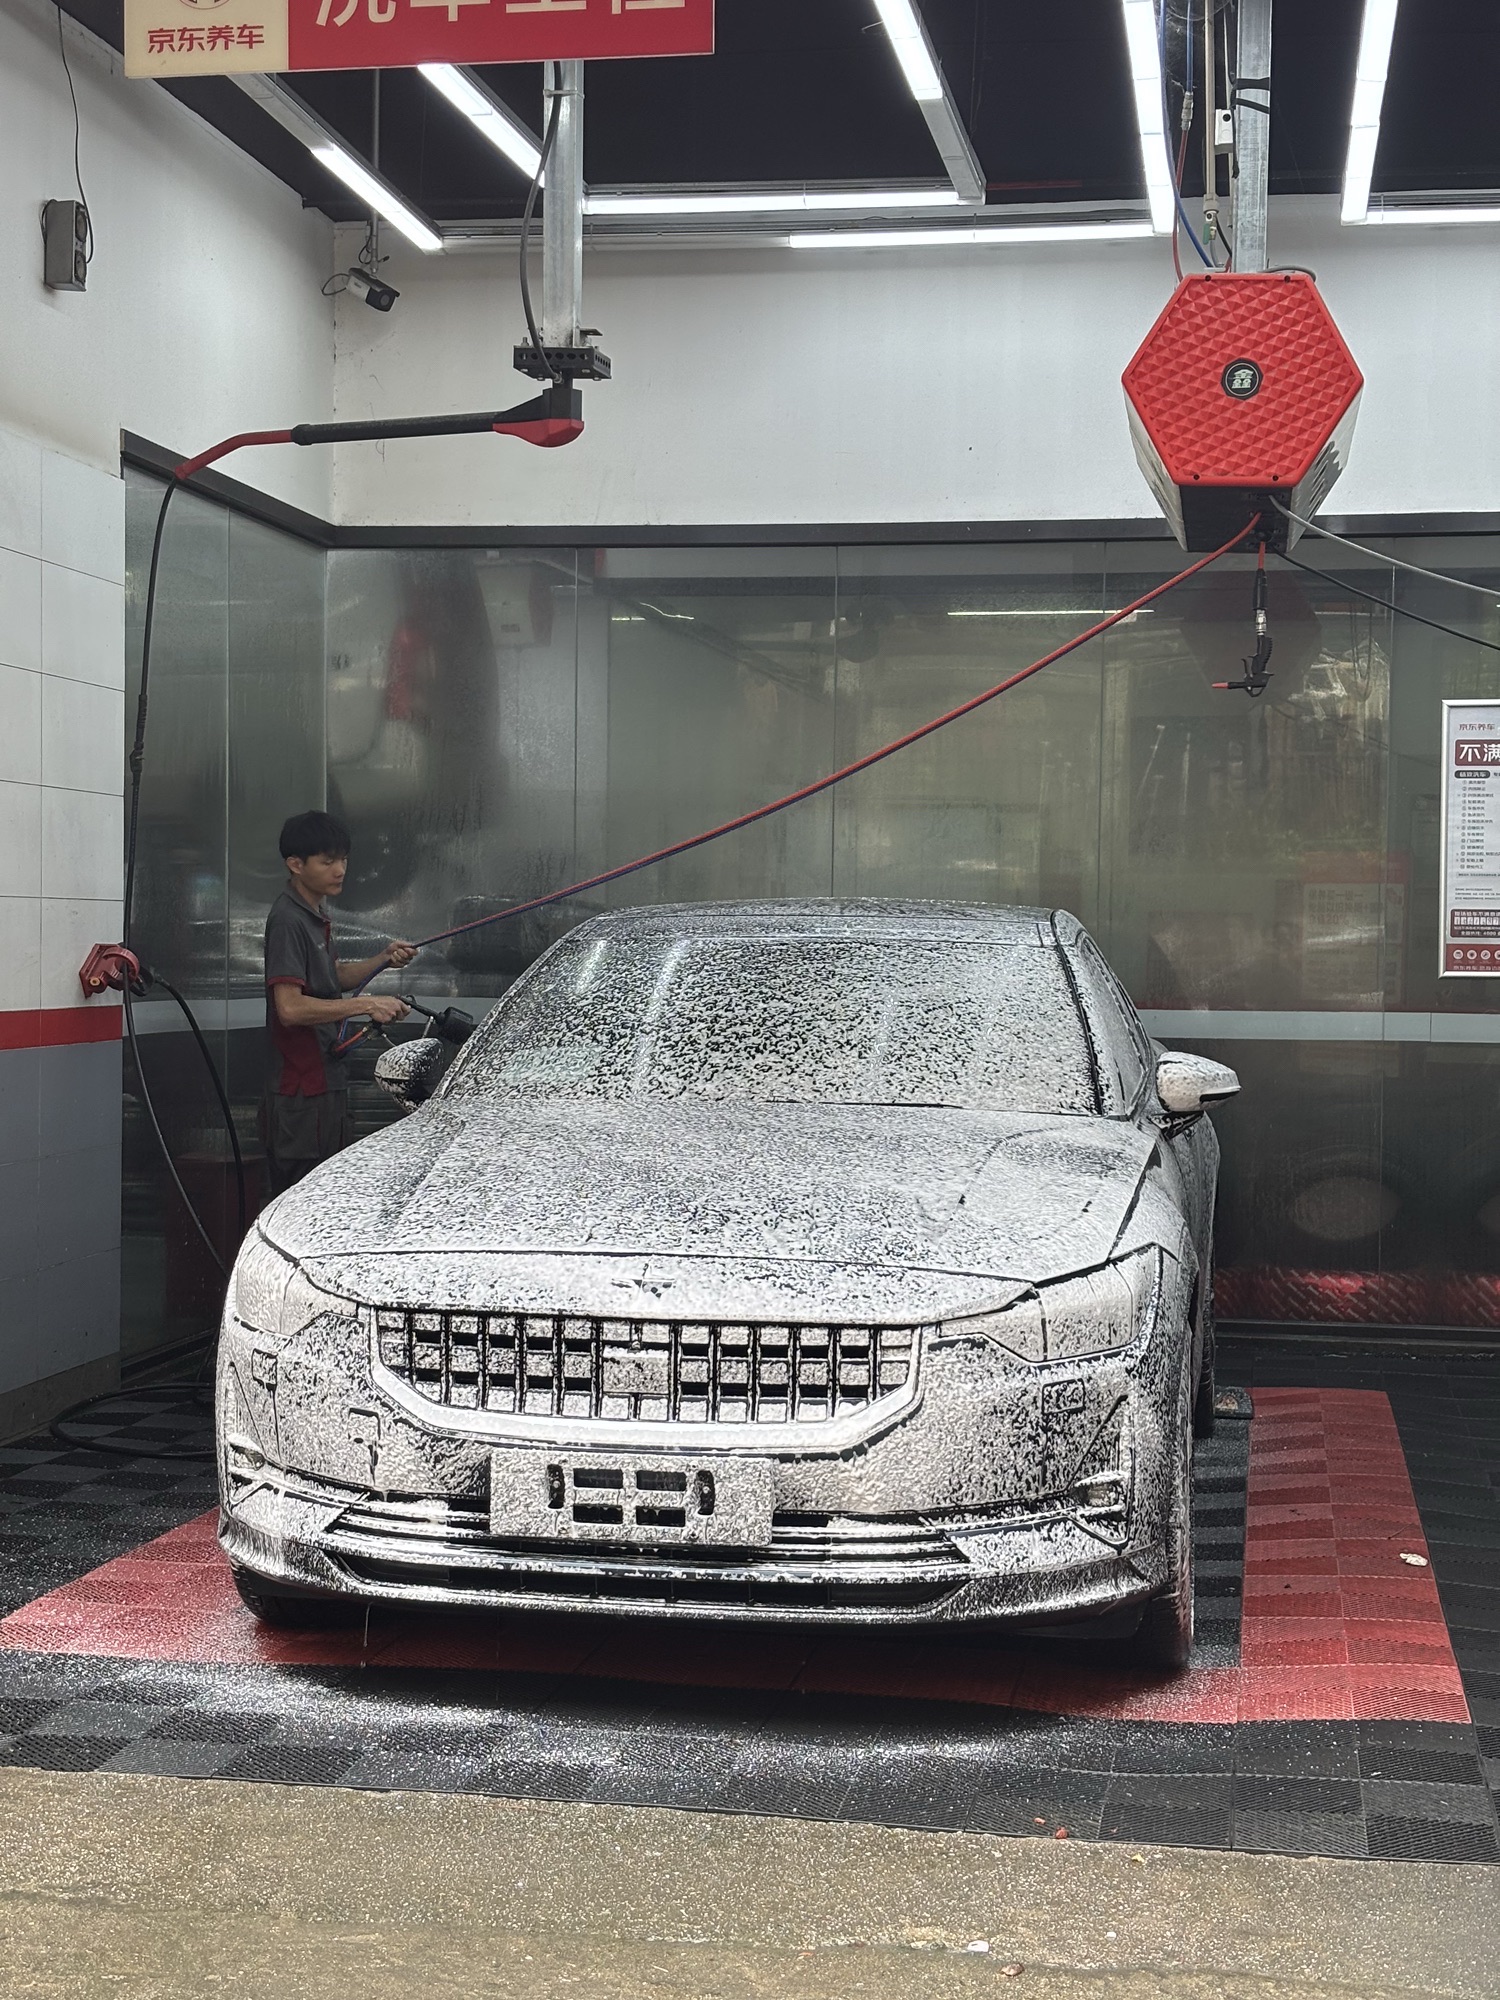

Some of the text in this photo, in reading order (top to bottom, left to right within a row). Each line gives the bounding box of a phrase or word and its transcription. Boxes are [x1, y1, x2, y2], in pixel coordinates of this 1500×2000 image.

[148, 24, 264, 53] 京东养车
[1459, 723, 1495, 731] 京东养车
[1459, 743, 1500, 762] 不满
